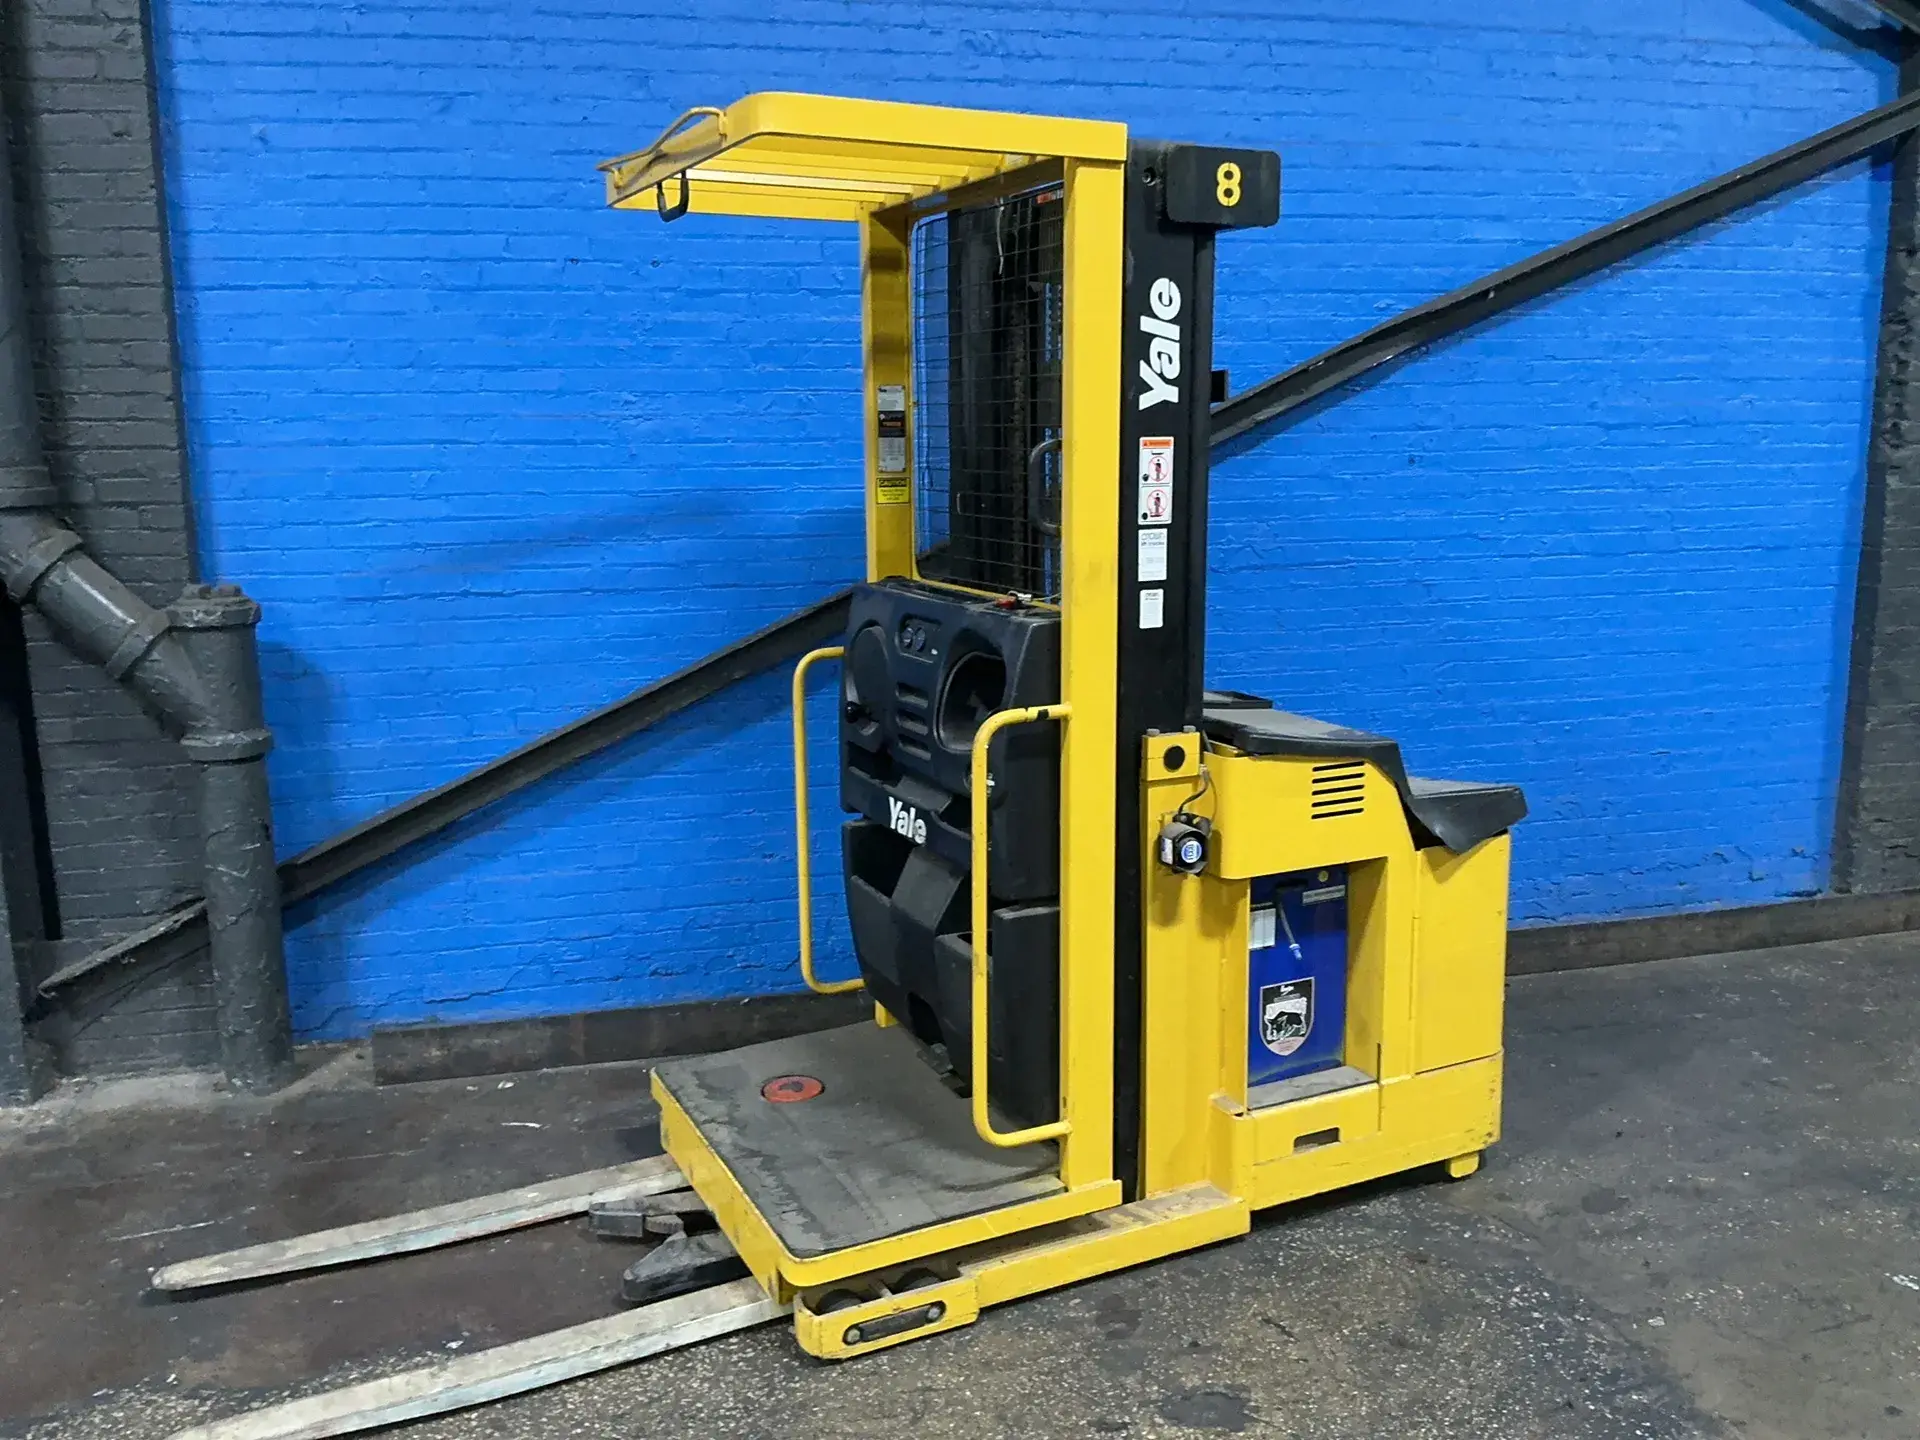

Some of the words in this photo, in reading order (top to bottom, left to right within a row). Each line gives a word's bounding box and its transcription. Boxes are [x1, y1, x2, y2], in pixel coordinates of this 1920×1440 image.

[1216, 162, 1242, 207] 8
[1138, 277, 1182, 411] Yale
[888, 797, 928, 844] Yale
